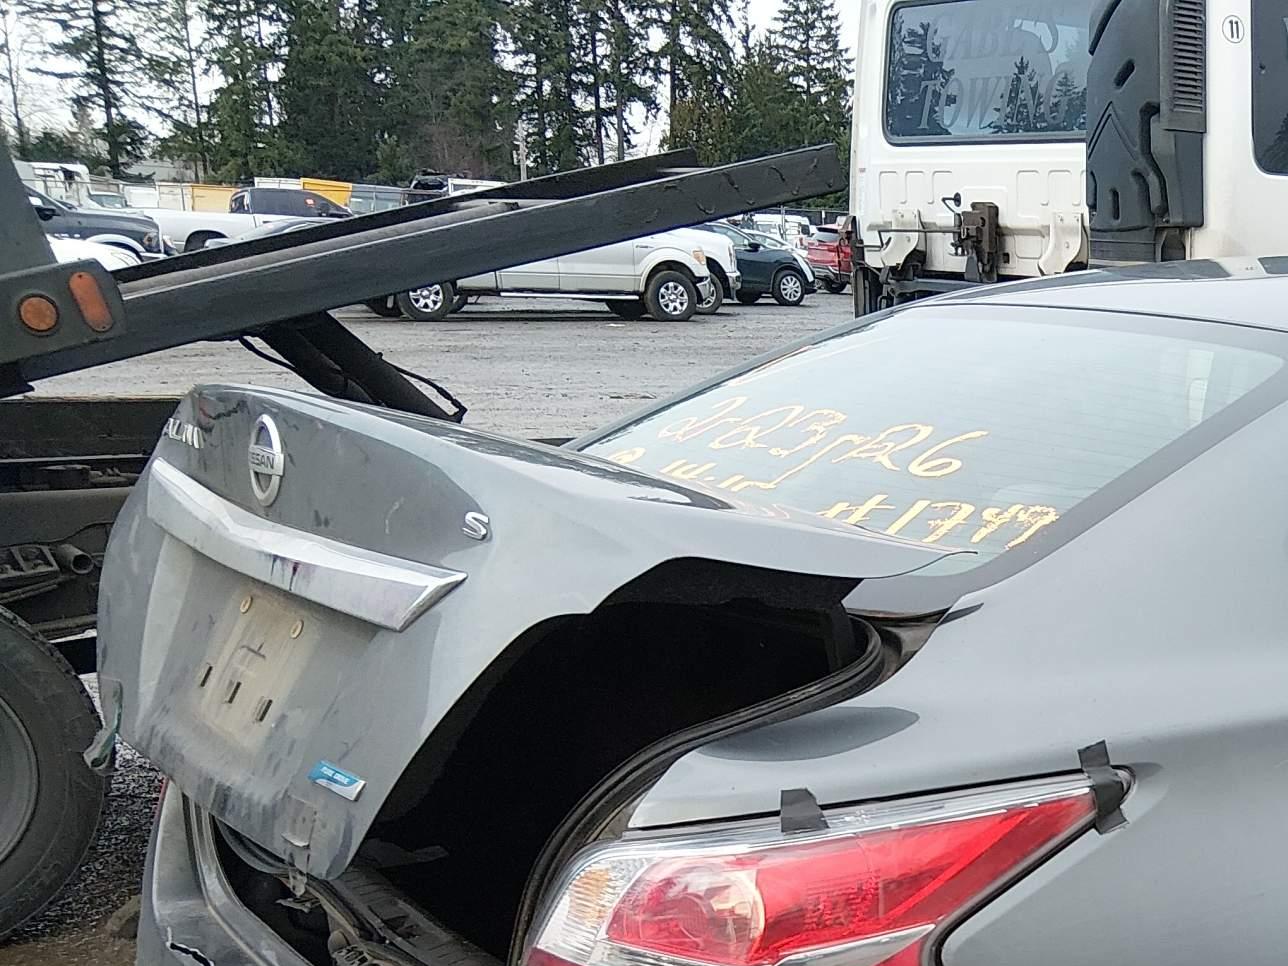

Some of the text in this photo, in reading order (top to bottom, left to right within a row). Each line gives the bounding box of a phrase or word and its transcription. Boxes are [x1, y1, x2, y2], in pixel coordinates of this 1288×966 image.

[1228, 19, 1240, 39] 11
[917, 69, 1068, 130] TOWING
[462, 511, 489, 541] S
